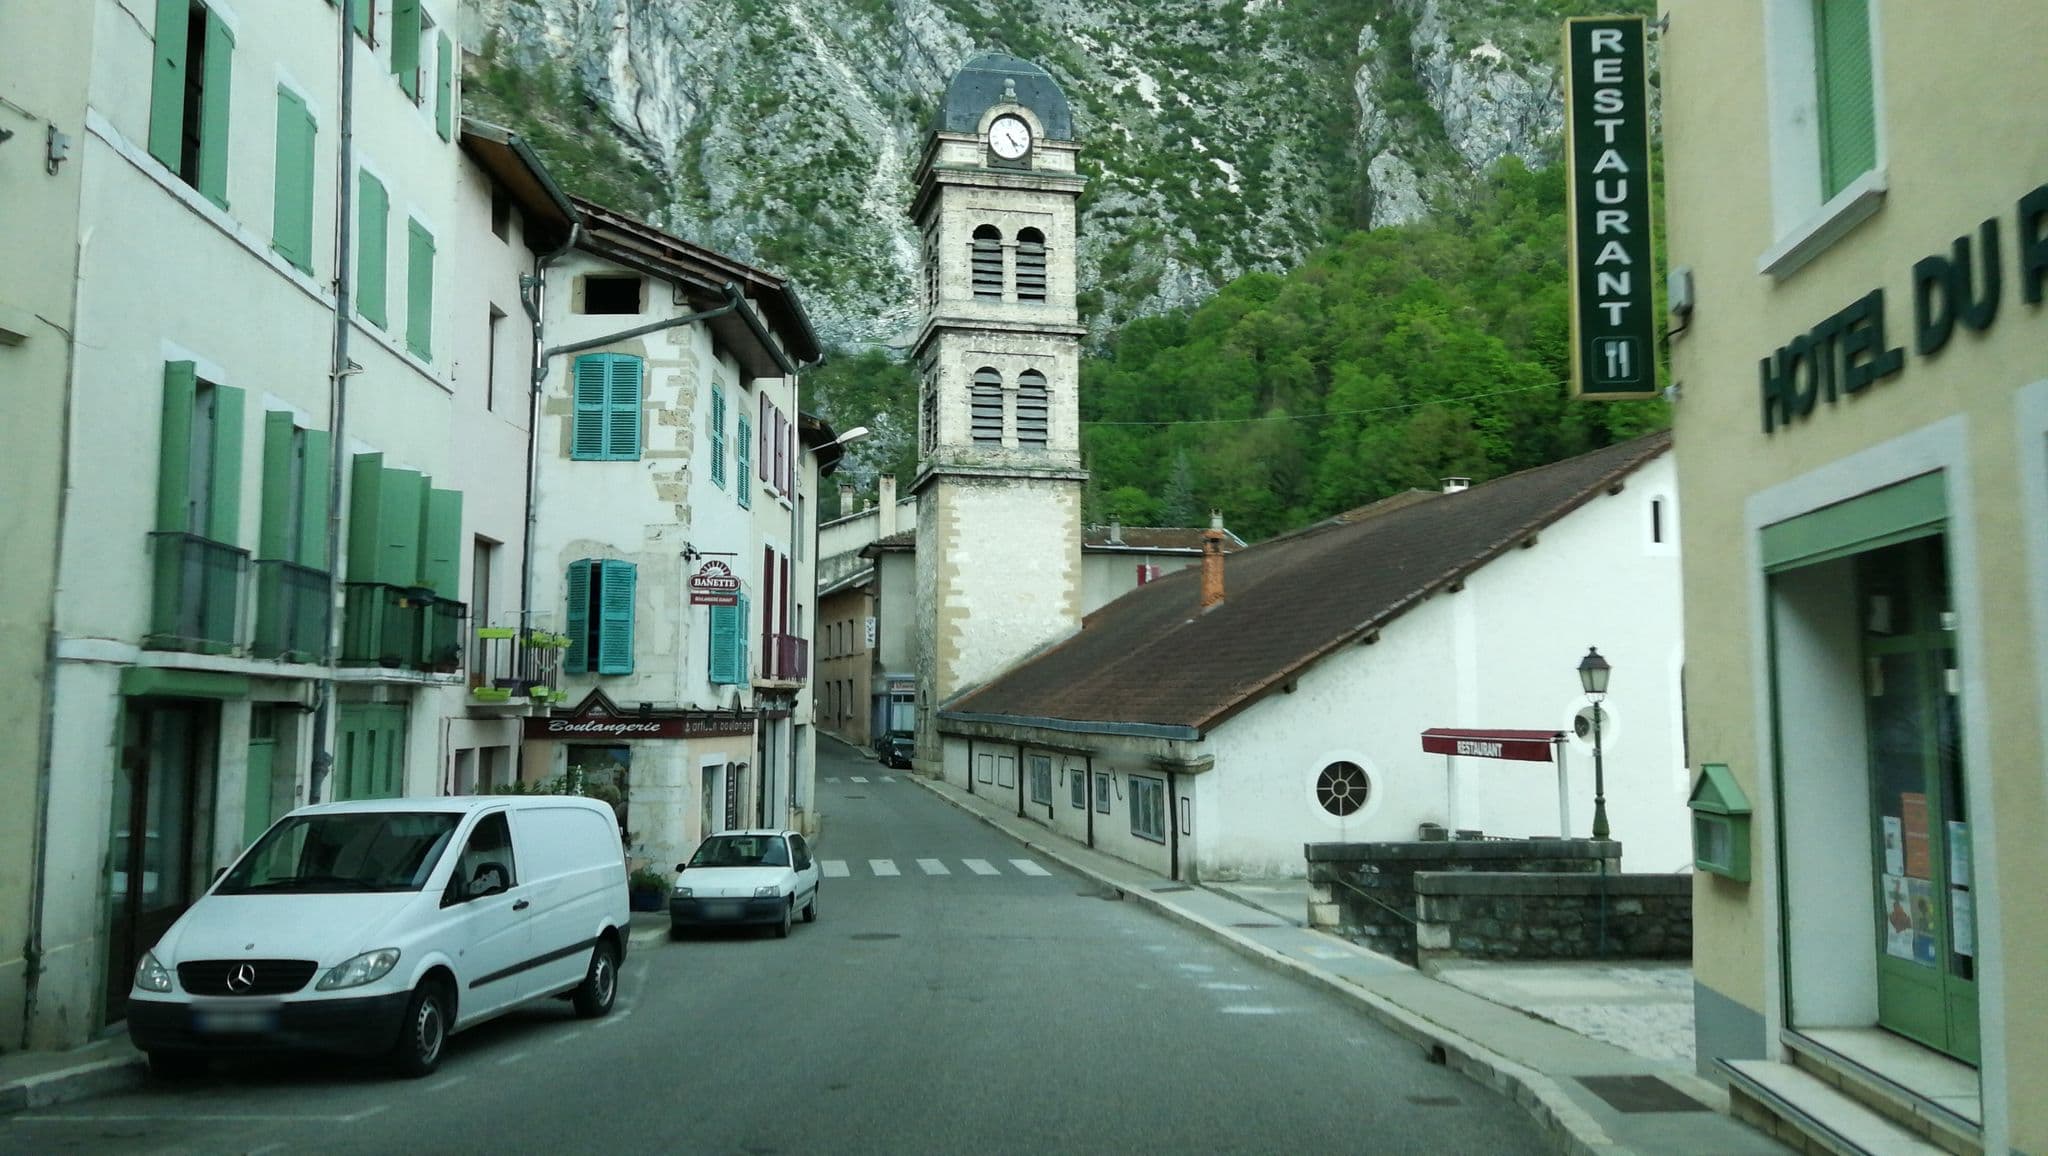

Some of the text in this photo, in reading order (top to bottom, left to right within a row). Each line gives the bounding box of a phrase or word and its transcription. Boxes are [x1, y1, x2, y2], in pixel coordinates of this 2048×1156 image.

[1591, 28, 1632, 327] RESTAURANT
[1759, 287, 1904, 434] HOTEL
[1913, 217, 2001, 357] DU
[694, 578, 735, 587] BANETTE
[547, 720, 661, 735] Boulangerie
[1457, 741, 1502, 757] RESTAURANT
